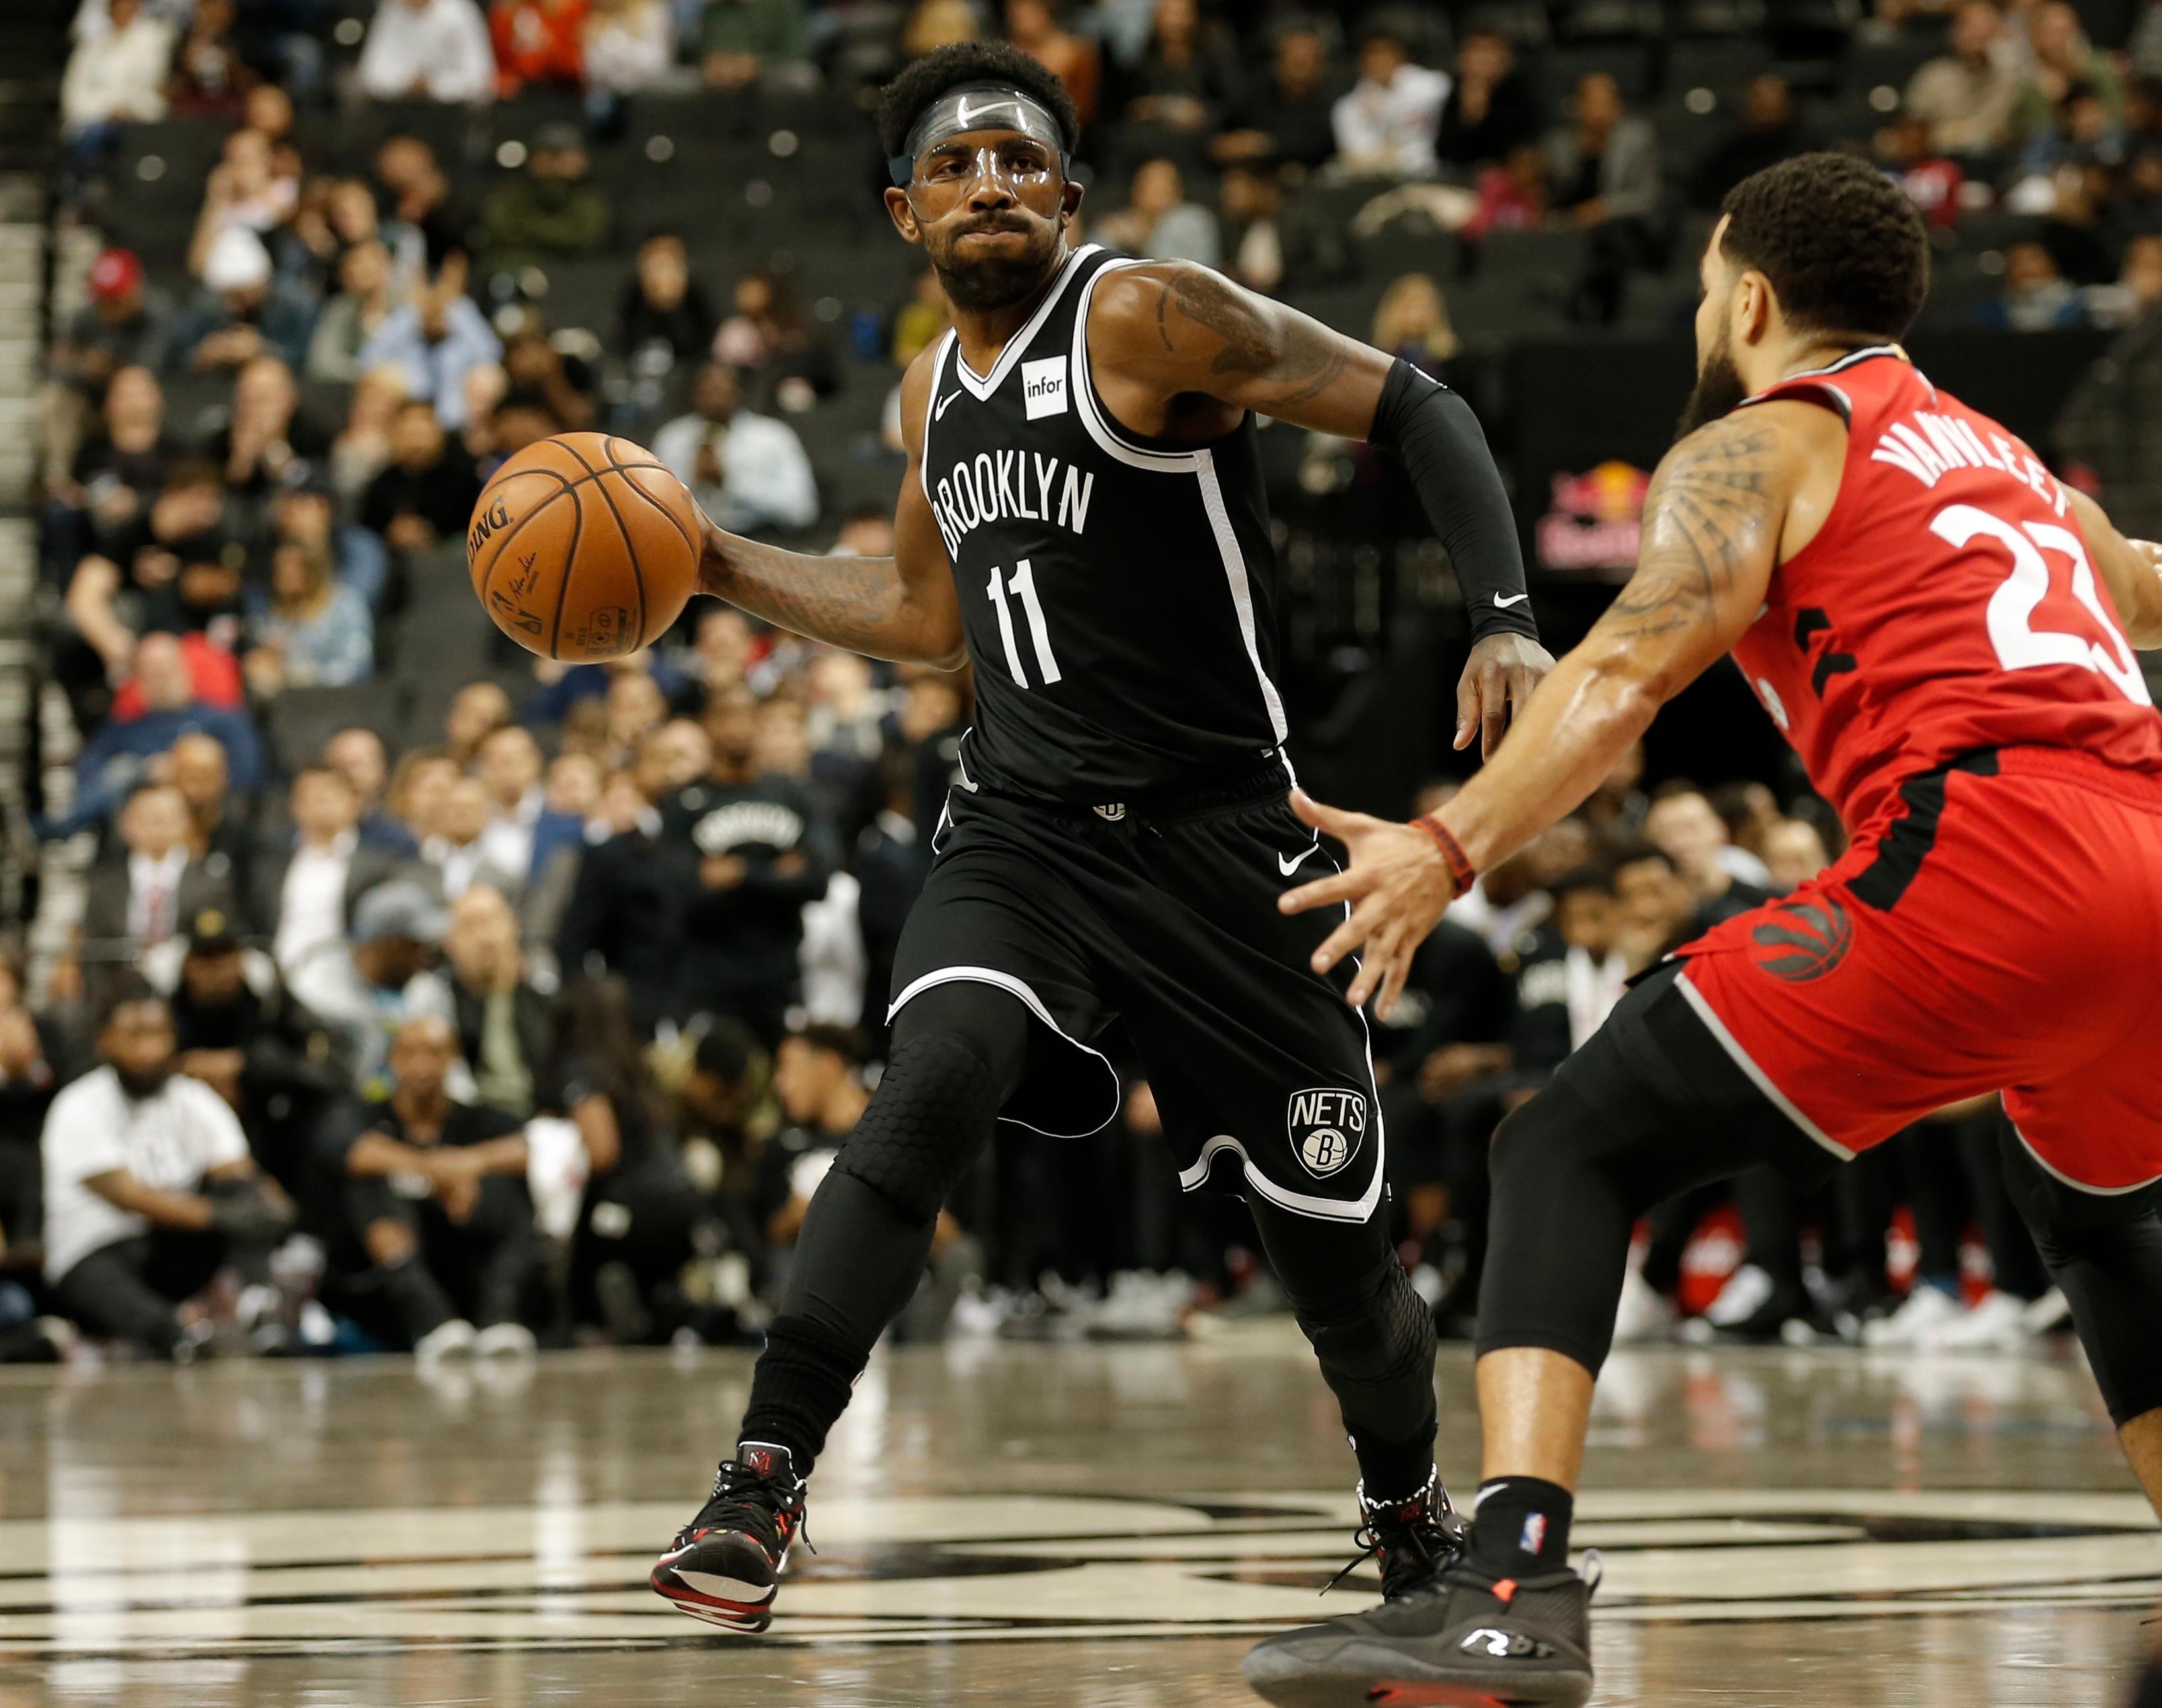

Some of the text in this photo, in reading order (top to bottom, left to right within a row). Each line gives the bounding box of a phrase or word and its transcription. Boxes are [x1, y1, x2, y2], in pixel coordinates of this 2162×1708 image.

[1027, 376, 1063, 399] infor
[932, 449, 1094, 563] BROOKLYN
[986, 558, 1062, 690] 11
[1929, 503, 2153, 708] 23
[1291, 1092, 1364, 1132] NETS
[1316, 1134, 1334, 1166] B
